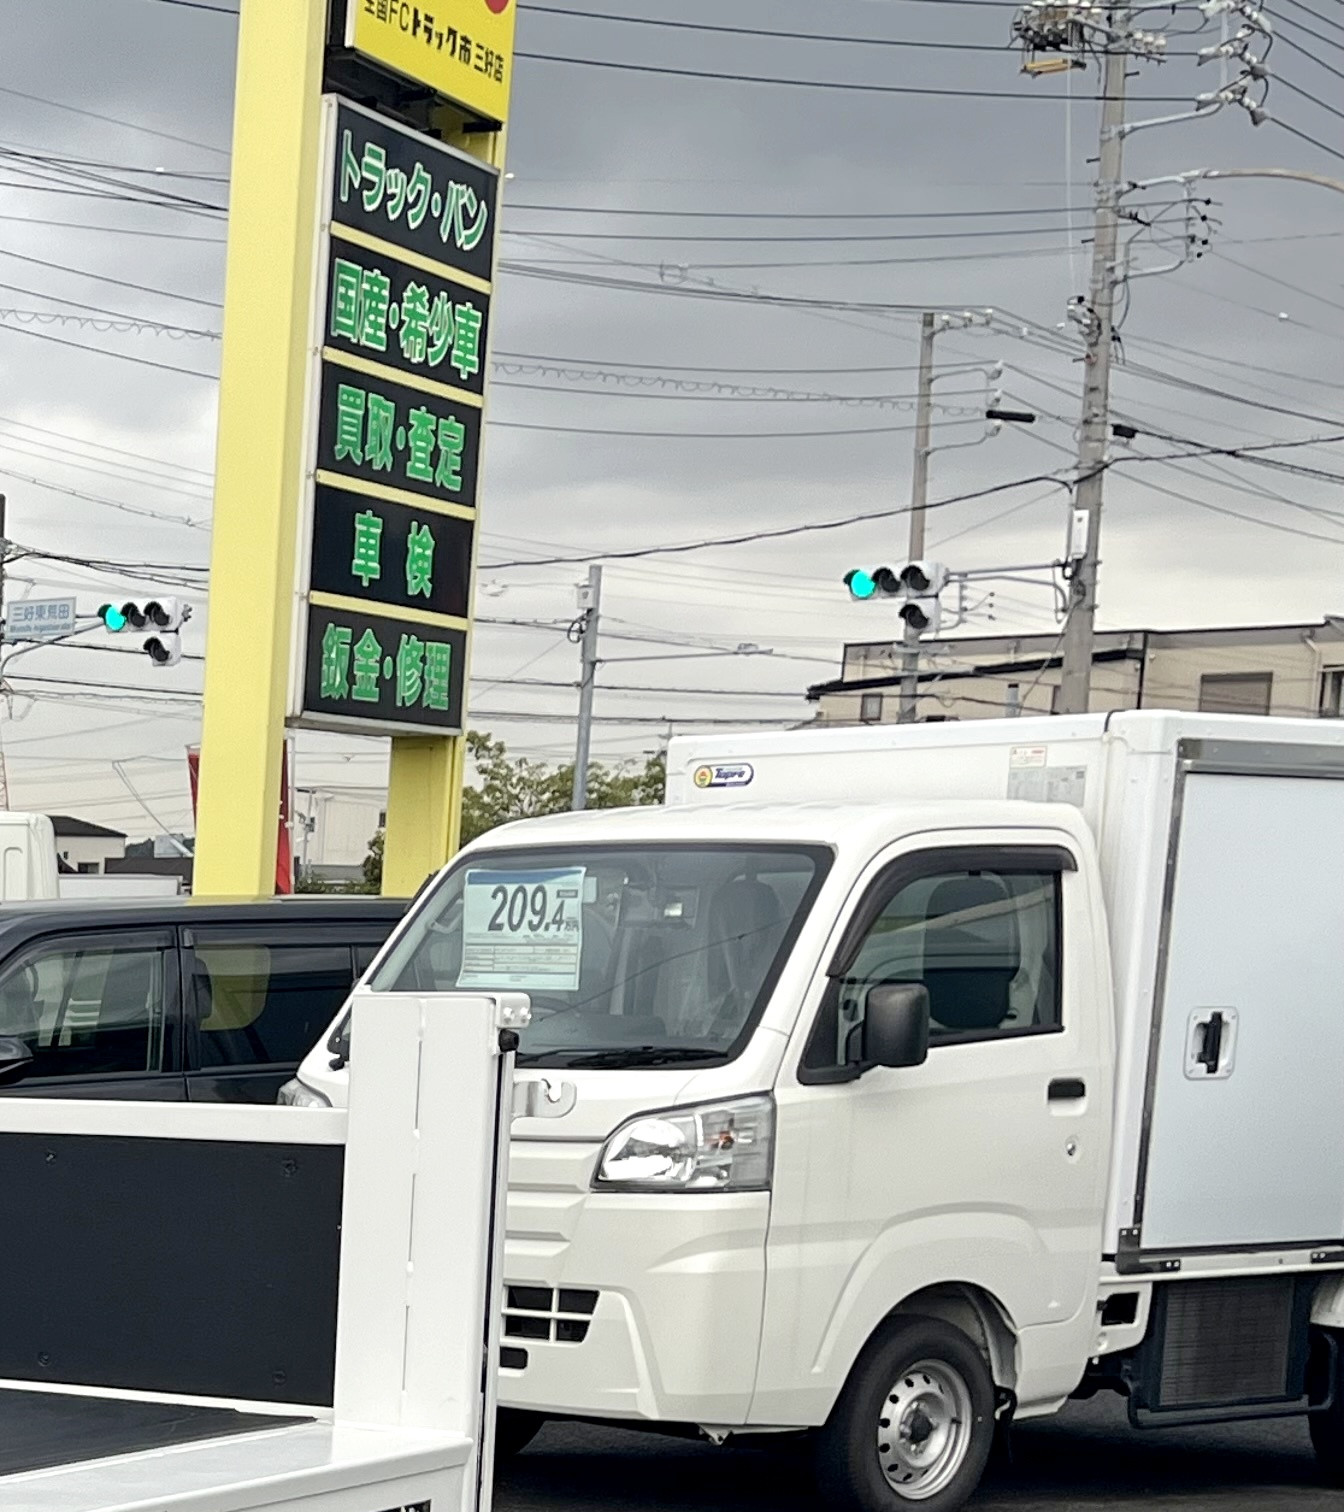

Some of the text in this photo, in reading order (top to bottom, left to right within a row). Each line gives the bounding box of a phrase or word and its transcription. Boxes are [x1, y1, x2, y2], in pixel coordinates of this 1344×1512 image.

[340, 129, 488, 251] トラック・バン
[331, 258, 482, 380] 国産・希少車
[334, 383, 464, 492] 買取・査定
